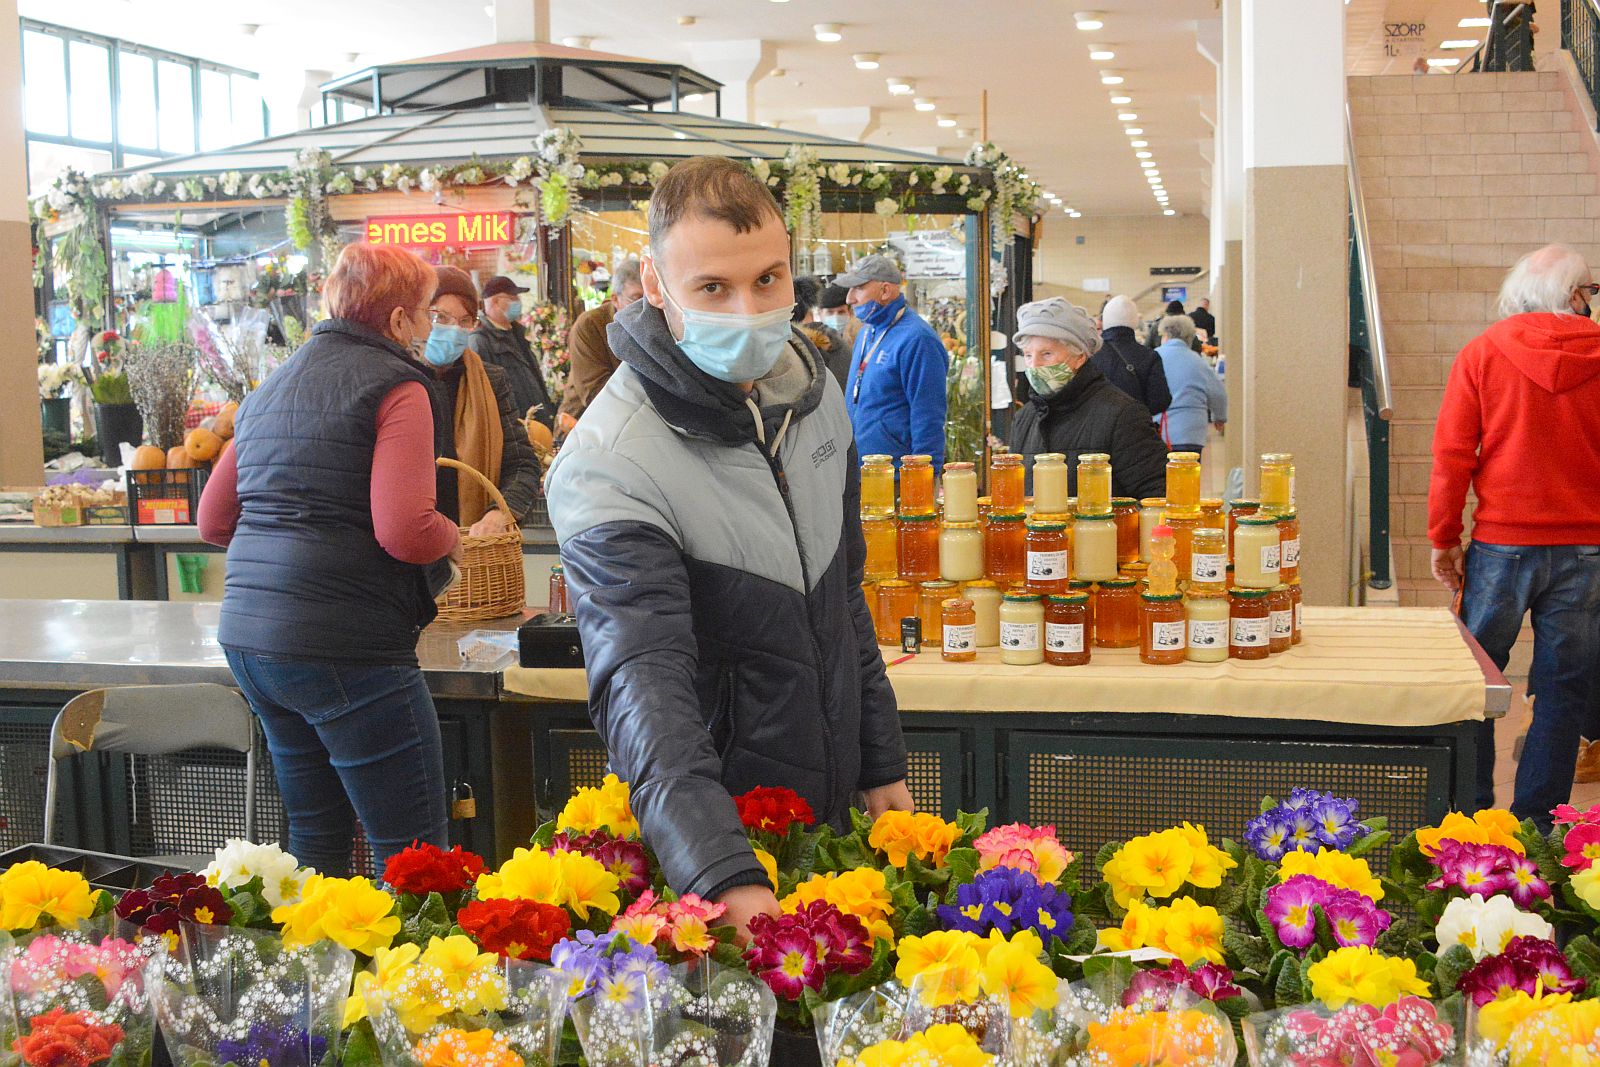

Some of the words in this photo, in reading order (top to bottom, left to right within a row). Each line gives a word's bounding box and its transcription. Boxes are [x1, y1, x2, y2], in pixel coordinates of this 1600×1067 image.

[1384, 22, 1426, 37] SZÖRP
[368, 222, 447, 245] emes
[458, 214, 508, 242] Mik
